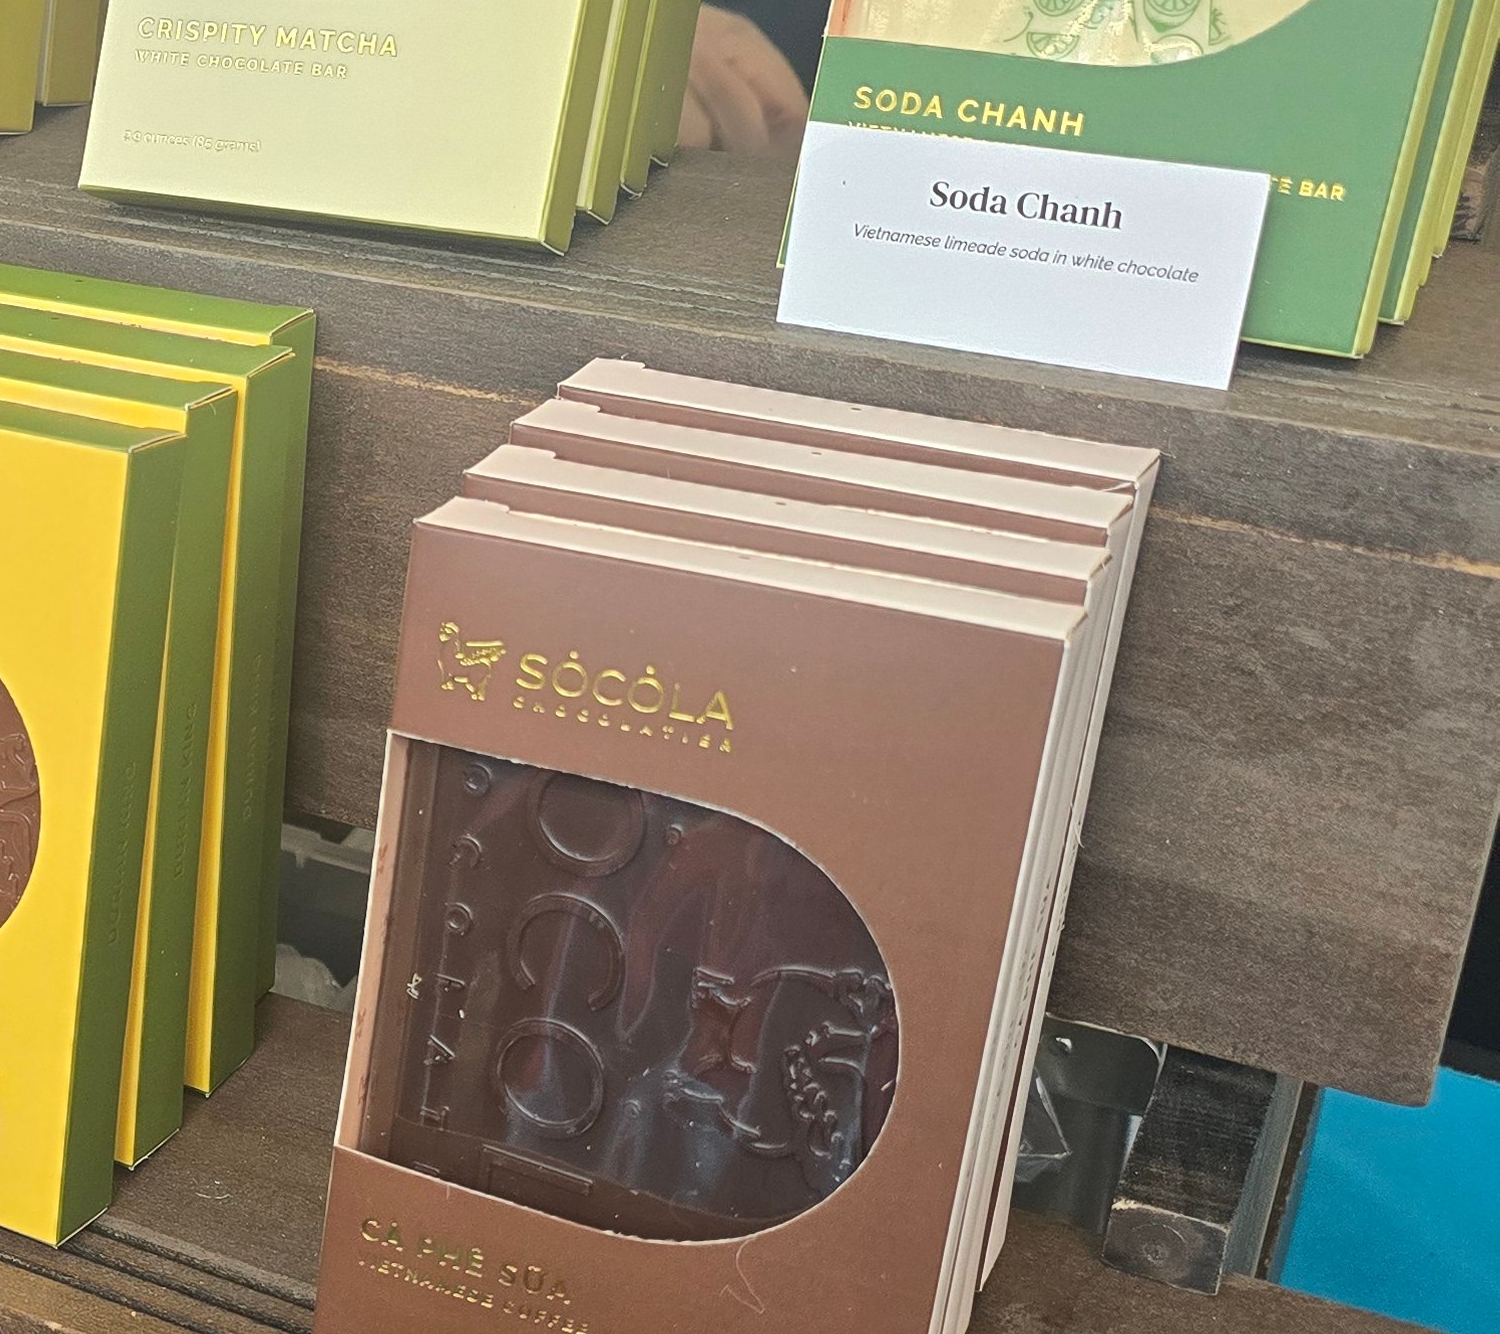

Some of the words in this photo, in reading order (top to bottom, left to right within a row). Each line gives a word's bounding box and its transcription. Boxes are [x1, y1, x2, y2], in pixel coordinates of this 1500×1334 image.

[137, 17, 267, 47] CRISPITY
[275, 26, 398, 58] MATCHA
[133, 49, 191, 67] WHITE
[196, 54, 305, 77] CHOCOLATE
[310, 62, 349, 79] BAR
[853, 85, 944, 120] SODA
[956, 97, 1086, 138] CHANH
[929, 180, 1008, 216] Soda
[1016, 191, 1123, 230] Chanh
[1298, 177, 1346, 202] BAR
[853, 223, 941, 249] Vietnamese
[944, 233, 1007, 260] limeade
[1009, 243, 1050, 265] soda
[1052, 249, 1068, 267] in
[1071, 250, 1115, 274] white
[1116, 258, 1200, 284] chocolate
